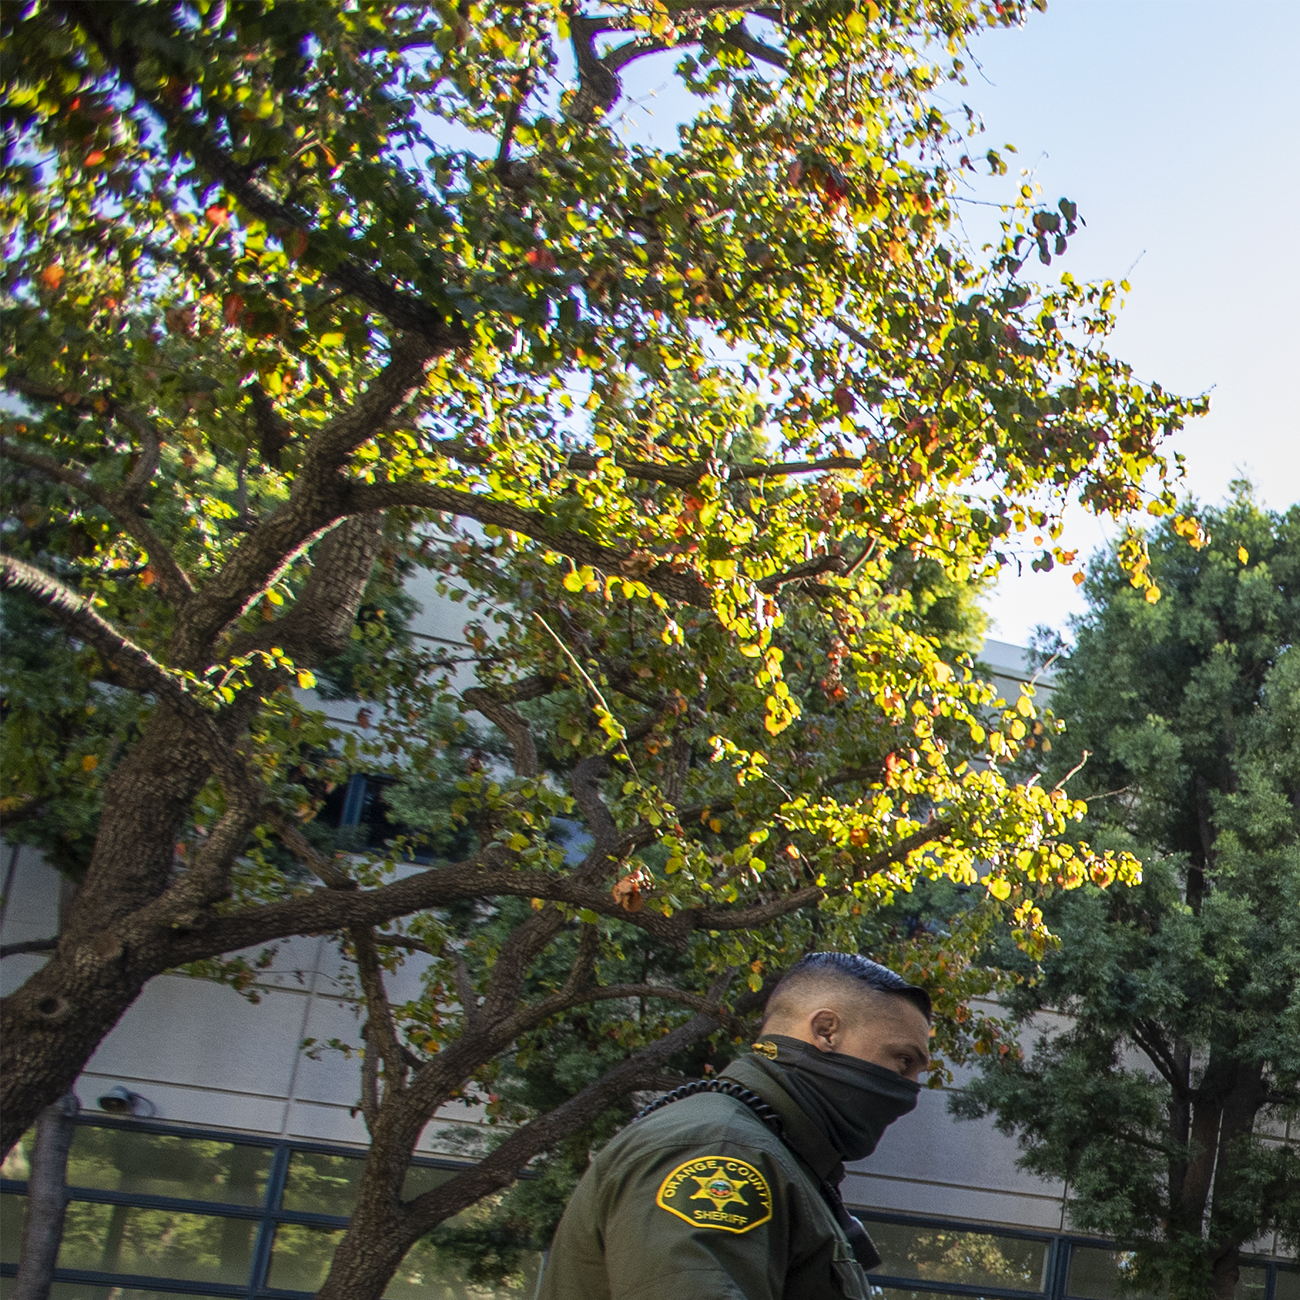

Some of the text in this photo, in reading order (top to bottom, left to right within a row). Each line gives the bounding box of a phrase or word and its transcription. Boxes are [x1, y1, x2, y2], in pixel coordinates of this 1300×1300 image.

[664, 1161, 771, 1209] ORANGE COUNTY
[694, 1210, 748, 1225] SHERIFF
